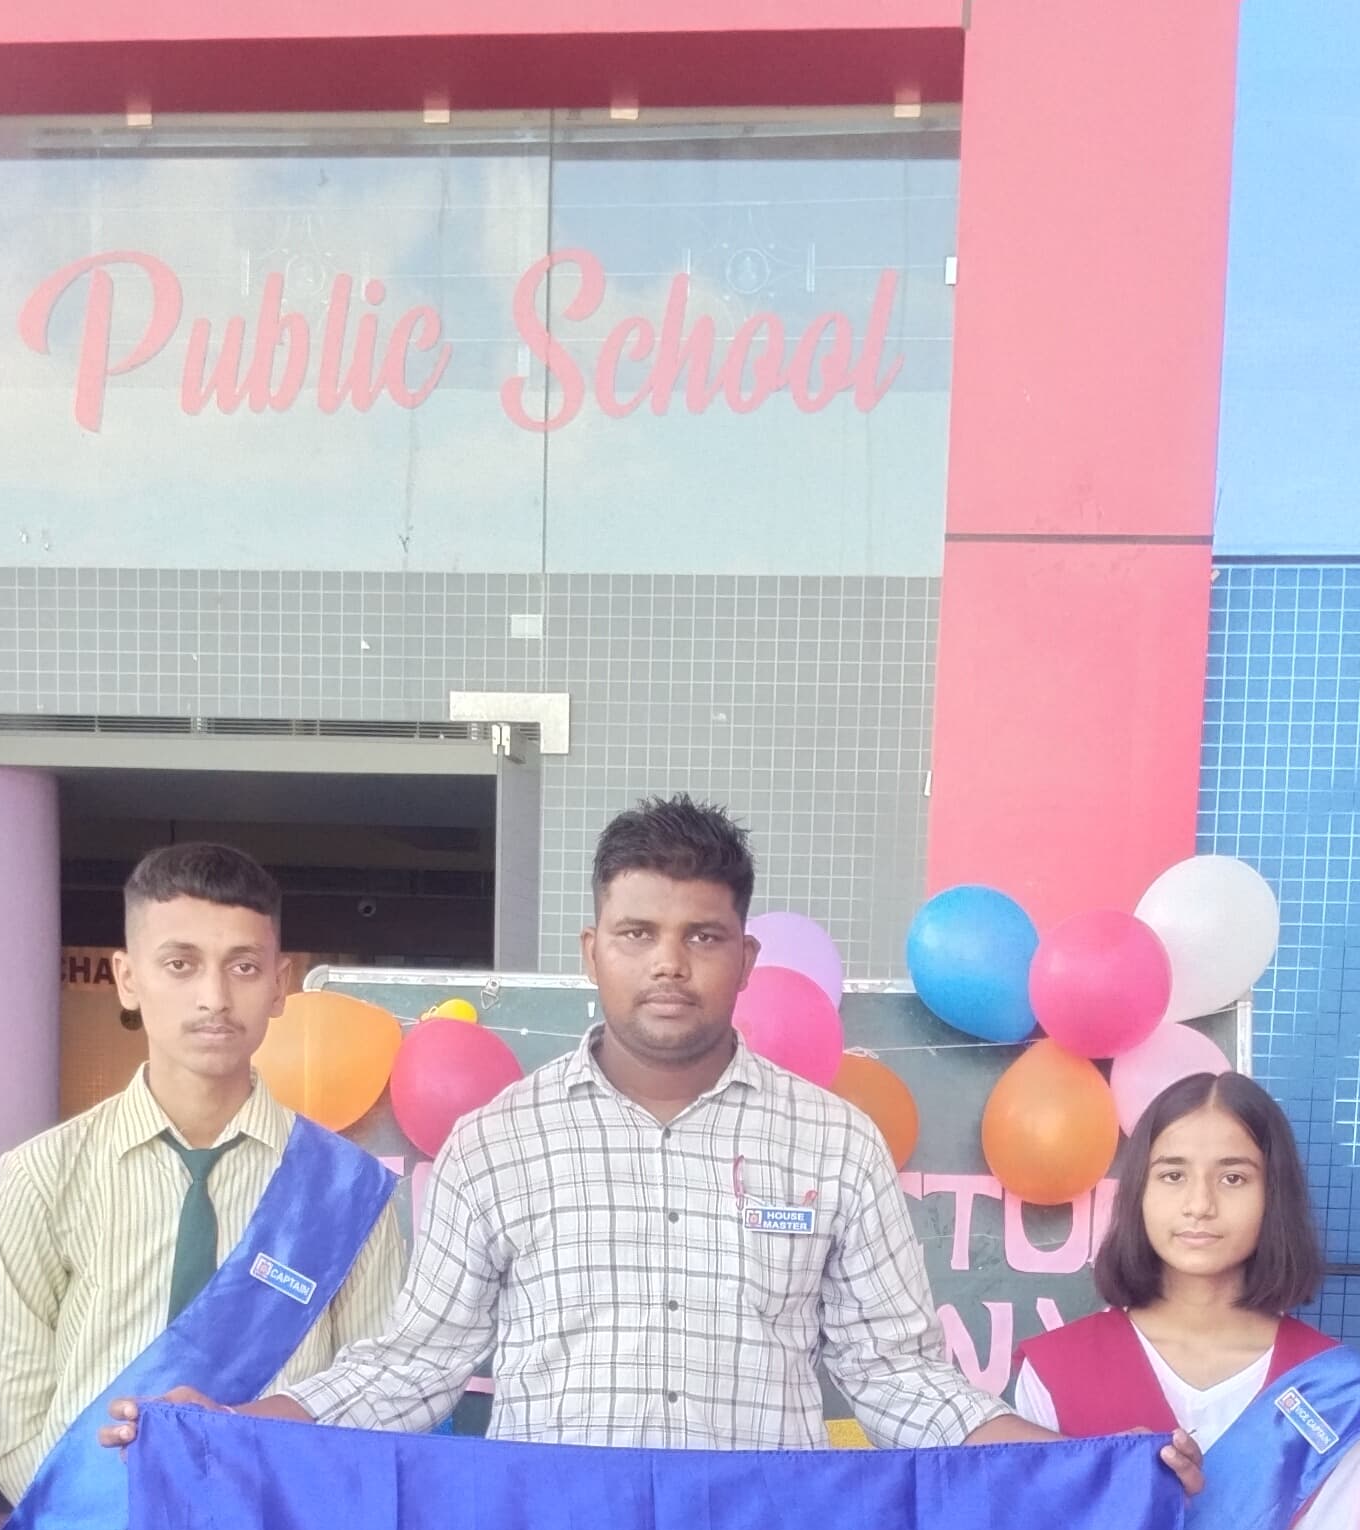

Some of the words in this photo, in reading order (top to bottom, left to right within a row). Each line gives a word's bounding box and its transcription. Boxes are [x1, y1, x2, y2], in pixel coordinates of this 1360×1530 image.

[18, 250, 451, 433] Public
[500, 248, 905, 433] School
[763, 1221, 807, 1230] MASTER
[766, 1211, 805, 1222] HOUSE
[271, 1269, 310, 1296] CAPTAIN
